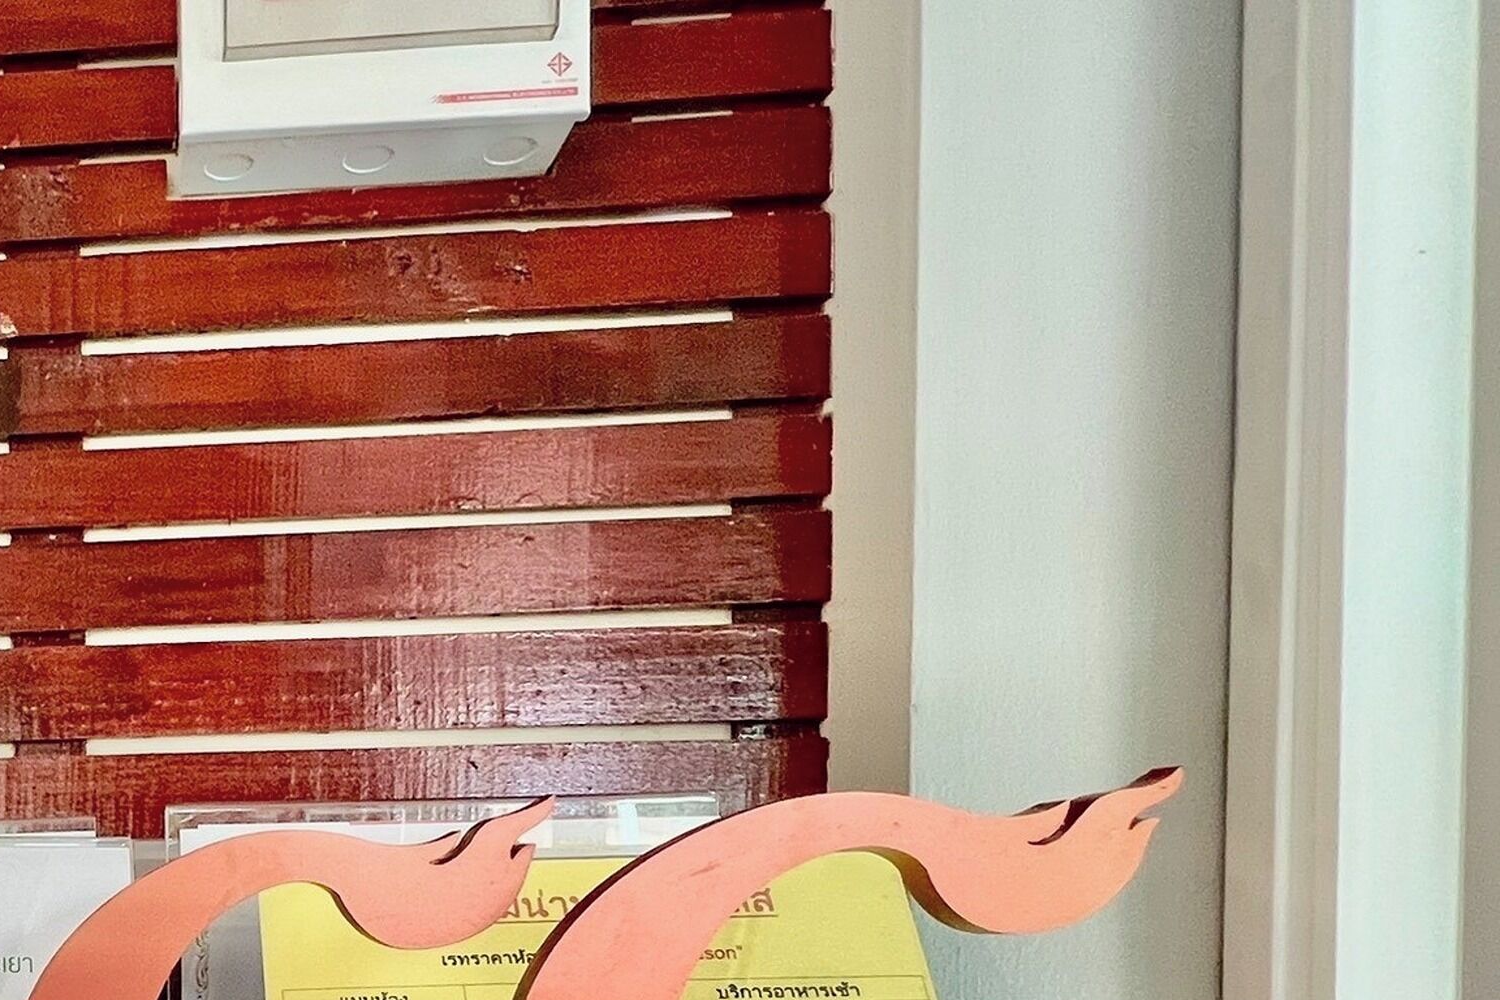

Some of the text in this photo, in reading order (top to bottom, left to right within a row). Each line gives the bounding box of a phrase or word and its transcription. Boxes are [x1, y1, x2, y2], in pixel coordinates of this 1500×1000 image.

[716, 981, 861, 1000] บริการอาหารเช้า
